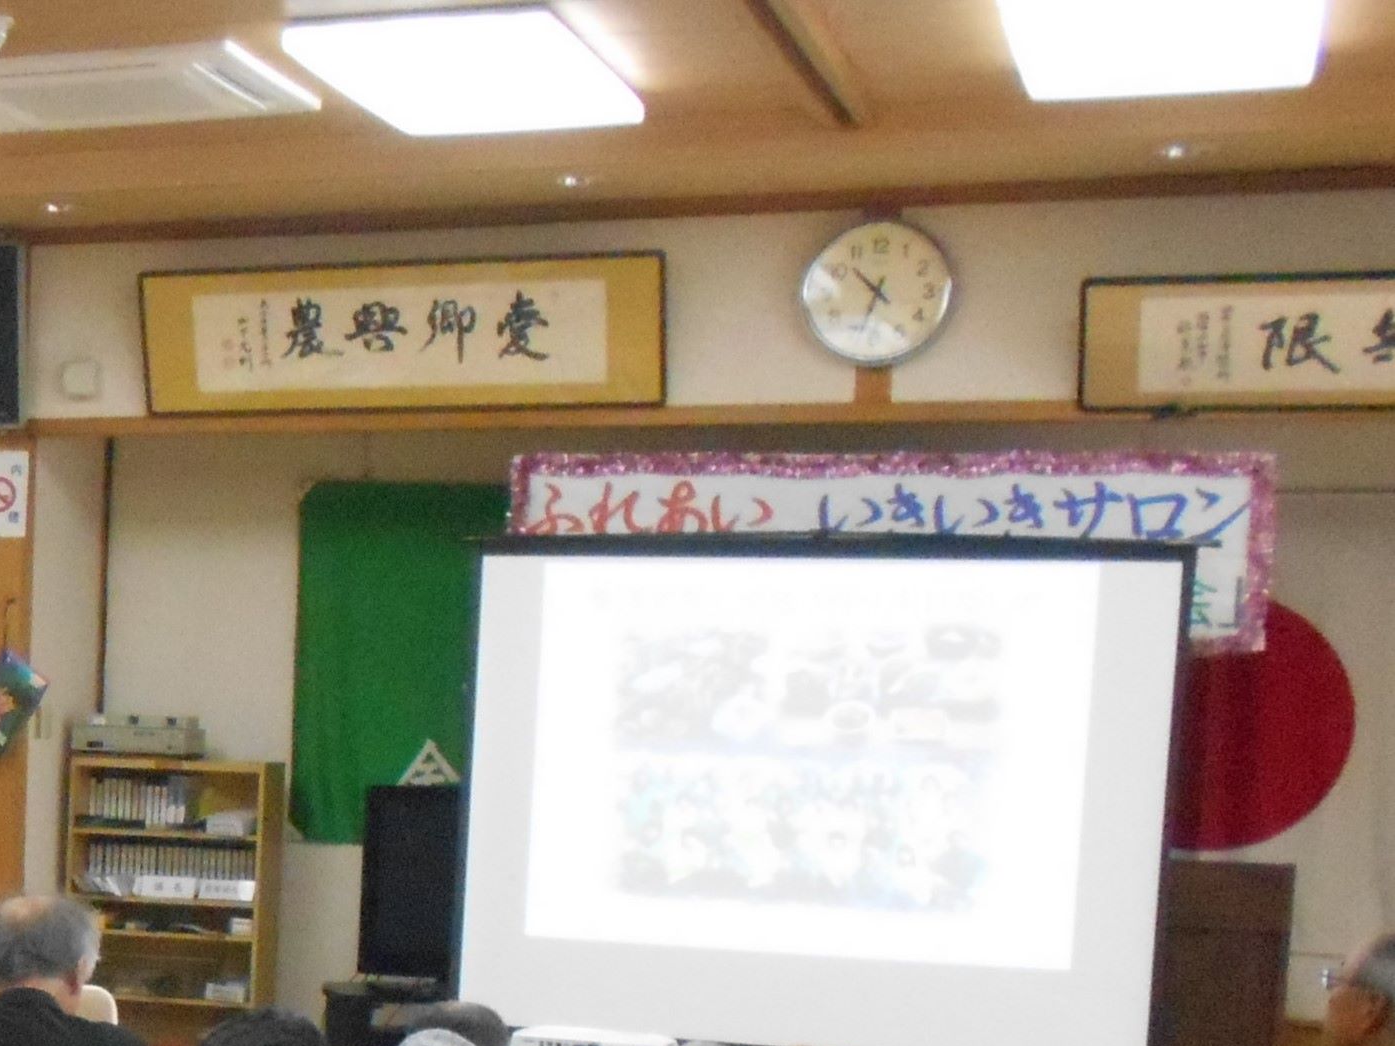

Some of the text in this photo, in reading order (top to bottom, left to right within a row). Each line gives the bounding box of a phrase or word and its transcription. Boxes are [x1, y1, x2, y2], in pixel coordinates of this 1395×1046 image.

[850, 244, 864, 260] 11
[872, 236, 890, 254] 12
[911, 306, 925, 323] 4
[525, 479, 1249, 541] ふれあい いきいきサロン
